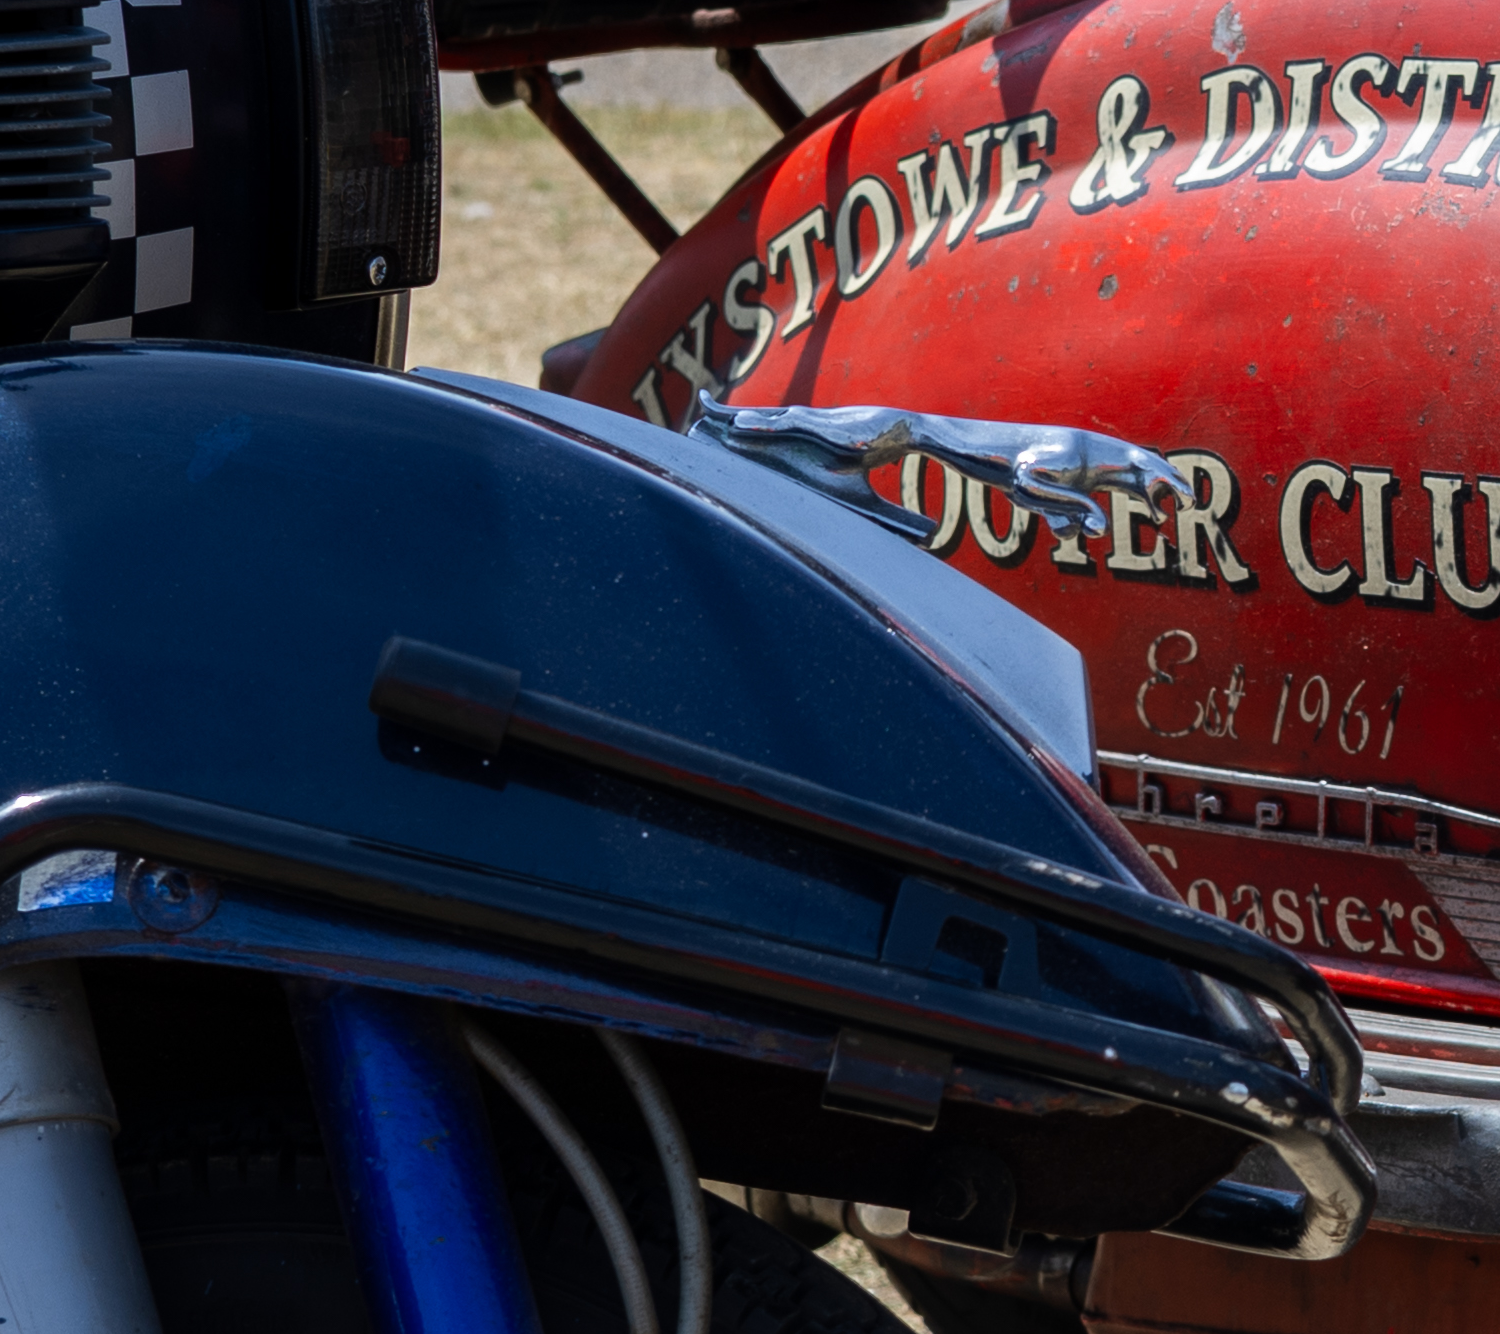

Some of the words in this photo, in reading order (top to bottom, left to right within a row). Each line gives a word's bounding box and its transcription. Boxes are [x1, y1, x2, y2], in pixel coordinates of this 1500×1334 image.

[632, 109, 1057, 435] IXSTOWE
[1070, 74, 1172, 216] &
[1136, 629, 1247, 740] Est
[1271, 672, 1405, 760] 1961
